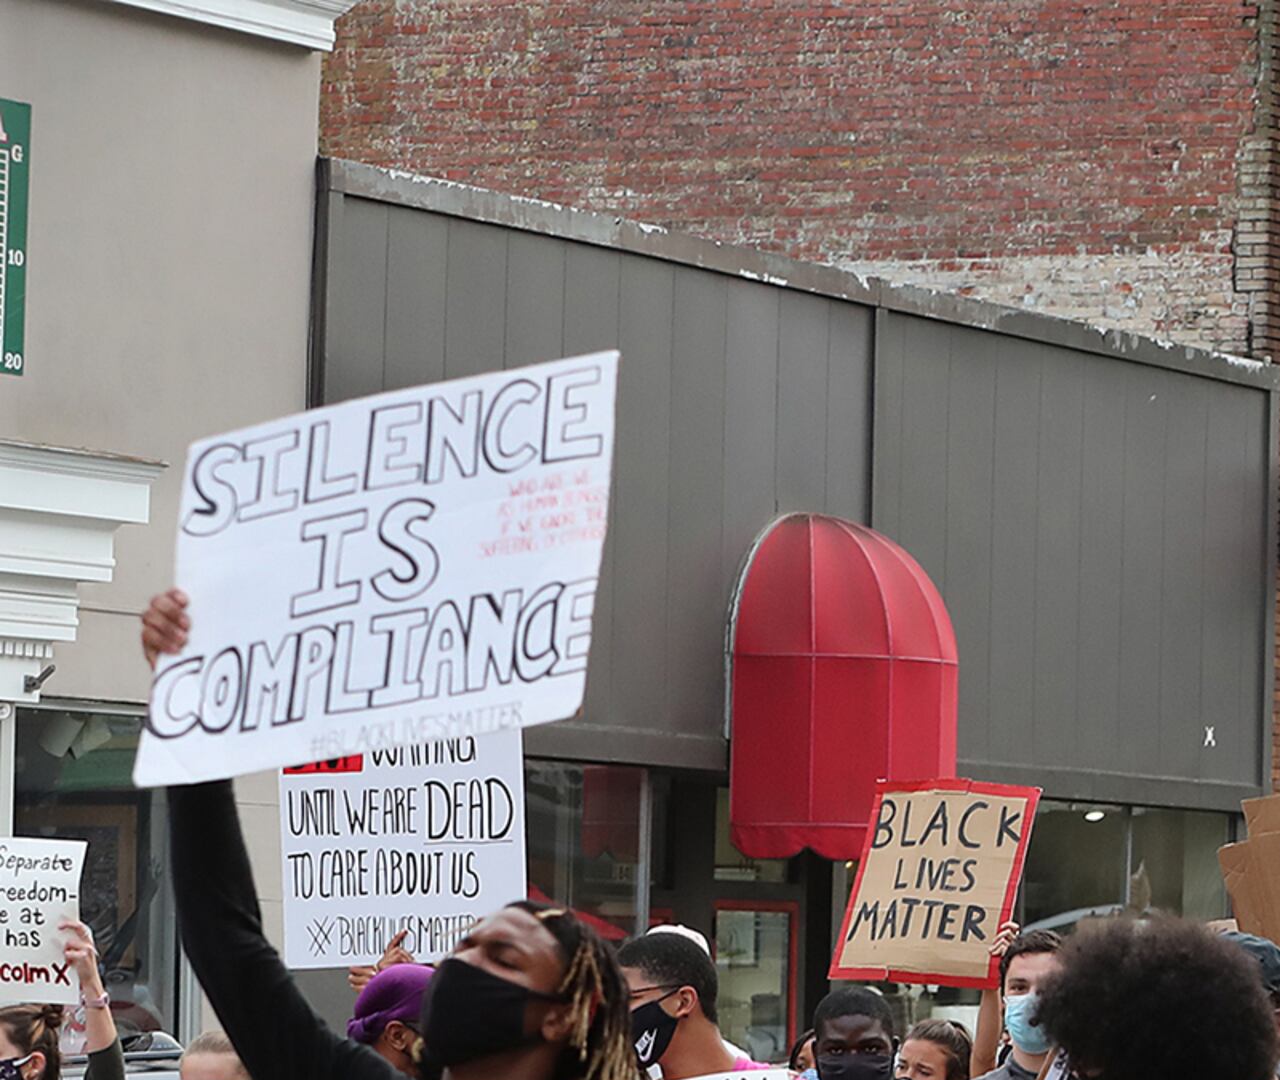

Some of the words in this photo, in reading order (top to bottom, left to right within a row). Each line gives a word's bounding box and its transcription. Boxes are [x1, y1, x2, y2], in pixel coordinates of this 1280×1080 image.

[11, 145, 23, 162] G
[8, 249, 24, 267] 10
[5, 353, 22, 371] 20
[182, 366, 603, 537] SILENCE
[290, 498, 440, 619] IS
[147, 578, 597, 739] COMPLIANCE
[288, 788, 340, 836] UNTIL
[343, 788, 378, 835] WE
[383, 787, 418, 834] ARE
[424, 777, 514, 839] DEAD
[871, 799, 1021, 848] BLACK
[288, 852, 313, 899] TO
[319, 850, 368, 898] CARE
[376, 848, 443, 896] ABOUT
[452, 852, 480, 898] US
[894, 857, 977, 892] LIVES
[6, 929, 41, 947] has
[20, 907, 45, 925] at
[307, 914, 488, 957] #BLACKLIESMATTE
[847, 897, 987, 942] MATTER
